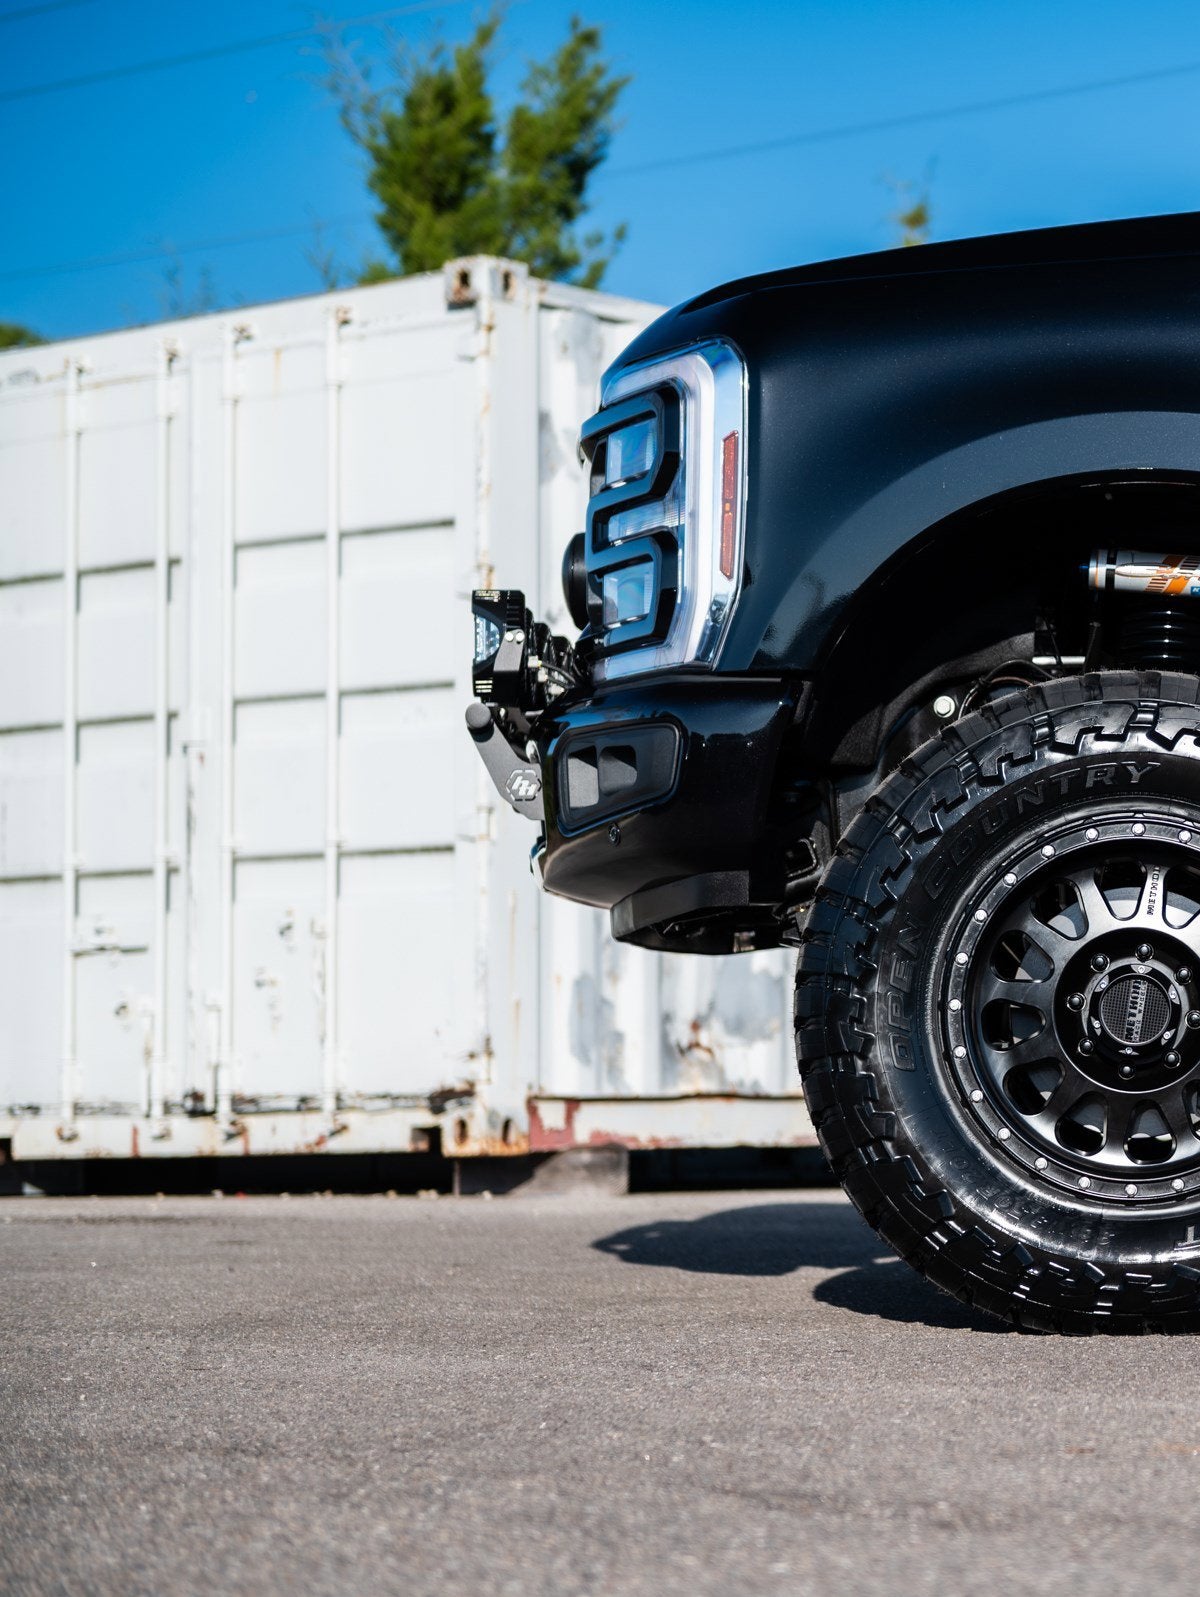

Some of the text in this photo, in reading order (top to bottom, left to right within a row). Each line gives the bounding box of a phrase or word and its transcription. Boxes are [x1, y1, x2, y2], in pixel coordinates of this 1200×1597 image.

[893, 761, 1161, 1072] OPEN COUNTRY
[1125, 980, 1141, 1041] METHOD
